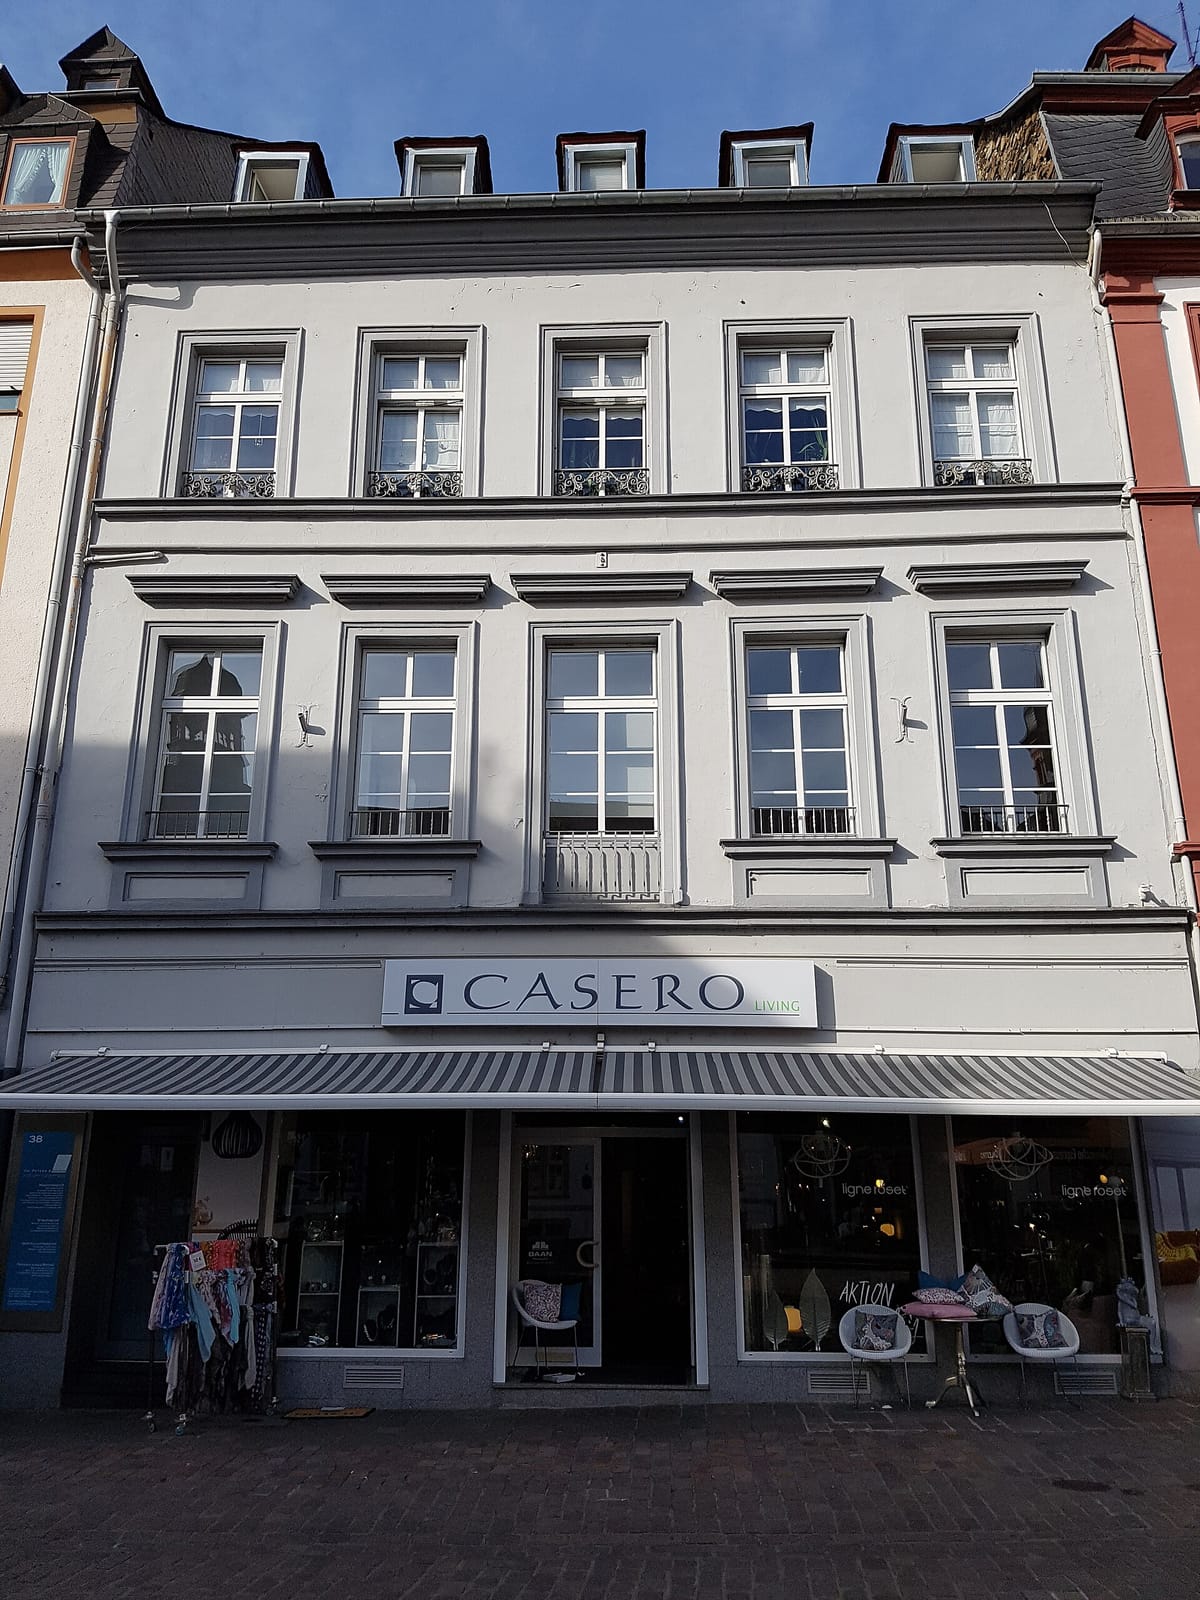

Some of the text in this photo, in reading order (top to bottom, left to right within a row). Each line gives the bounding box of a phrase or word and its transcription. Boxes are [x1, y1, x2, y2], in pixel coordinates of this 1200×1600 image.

[463, 971, 800, 1013] CASERO LIVING
[28, 1135, 43, 1144] 38
[841, 1183, 872, 1198] ligne
[1061, 1184, 1092, 1199] ligne
[839, 1280, 895, 1307] AKTION
